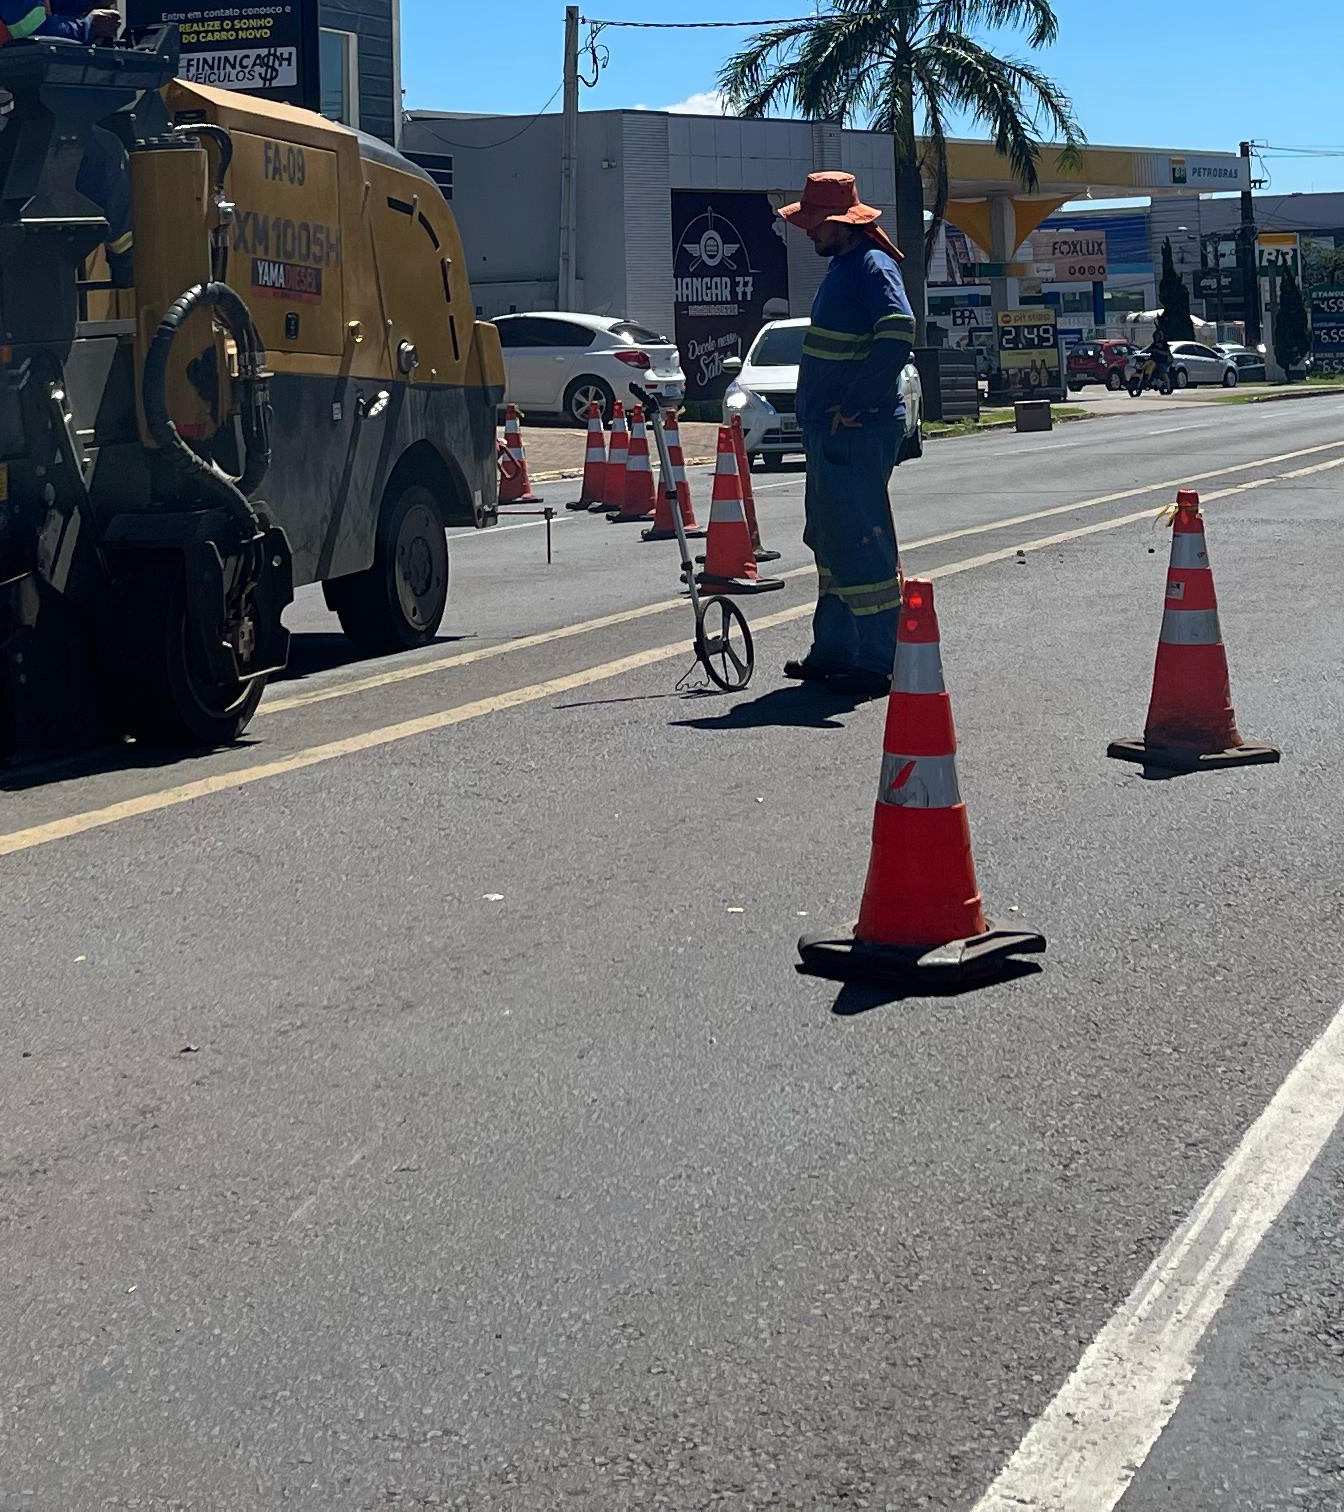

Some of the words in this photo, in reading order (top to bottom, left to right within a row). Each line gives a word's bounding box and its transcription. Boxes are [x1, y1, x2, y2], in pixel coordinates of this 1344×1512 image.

[161, 12, 186, 21] Entre
[187, 11, 202, 19] em
[203, 7, 240, 18] contato
[242, 6, 283, 16] conosco
[285, 5, 292, 13] e
[179, 20, 222, 33] REALIZE
[223, 20, 232, 29] O
[233, 18, 274, 29] SONHO
[182, 34, 198, 43] DO
[199, 31, 236, 42] CARRO
[238, 29, 271, 39] NOVO
[264, 141, 305, 186] FA-09
[1192, 167, 1238, 179] PETROBRAS
[233, 210, 342, 266] XM1005H
[1052, 240, 1105, 256] FOXLUX
[674, 277, 731, 302] HANGAR
[736, 276, 754, 301] 77
[952, 308, 980, 327] BPA
